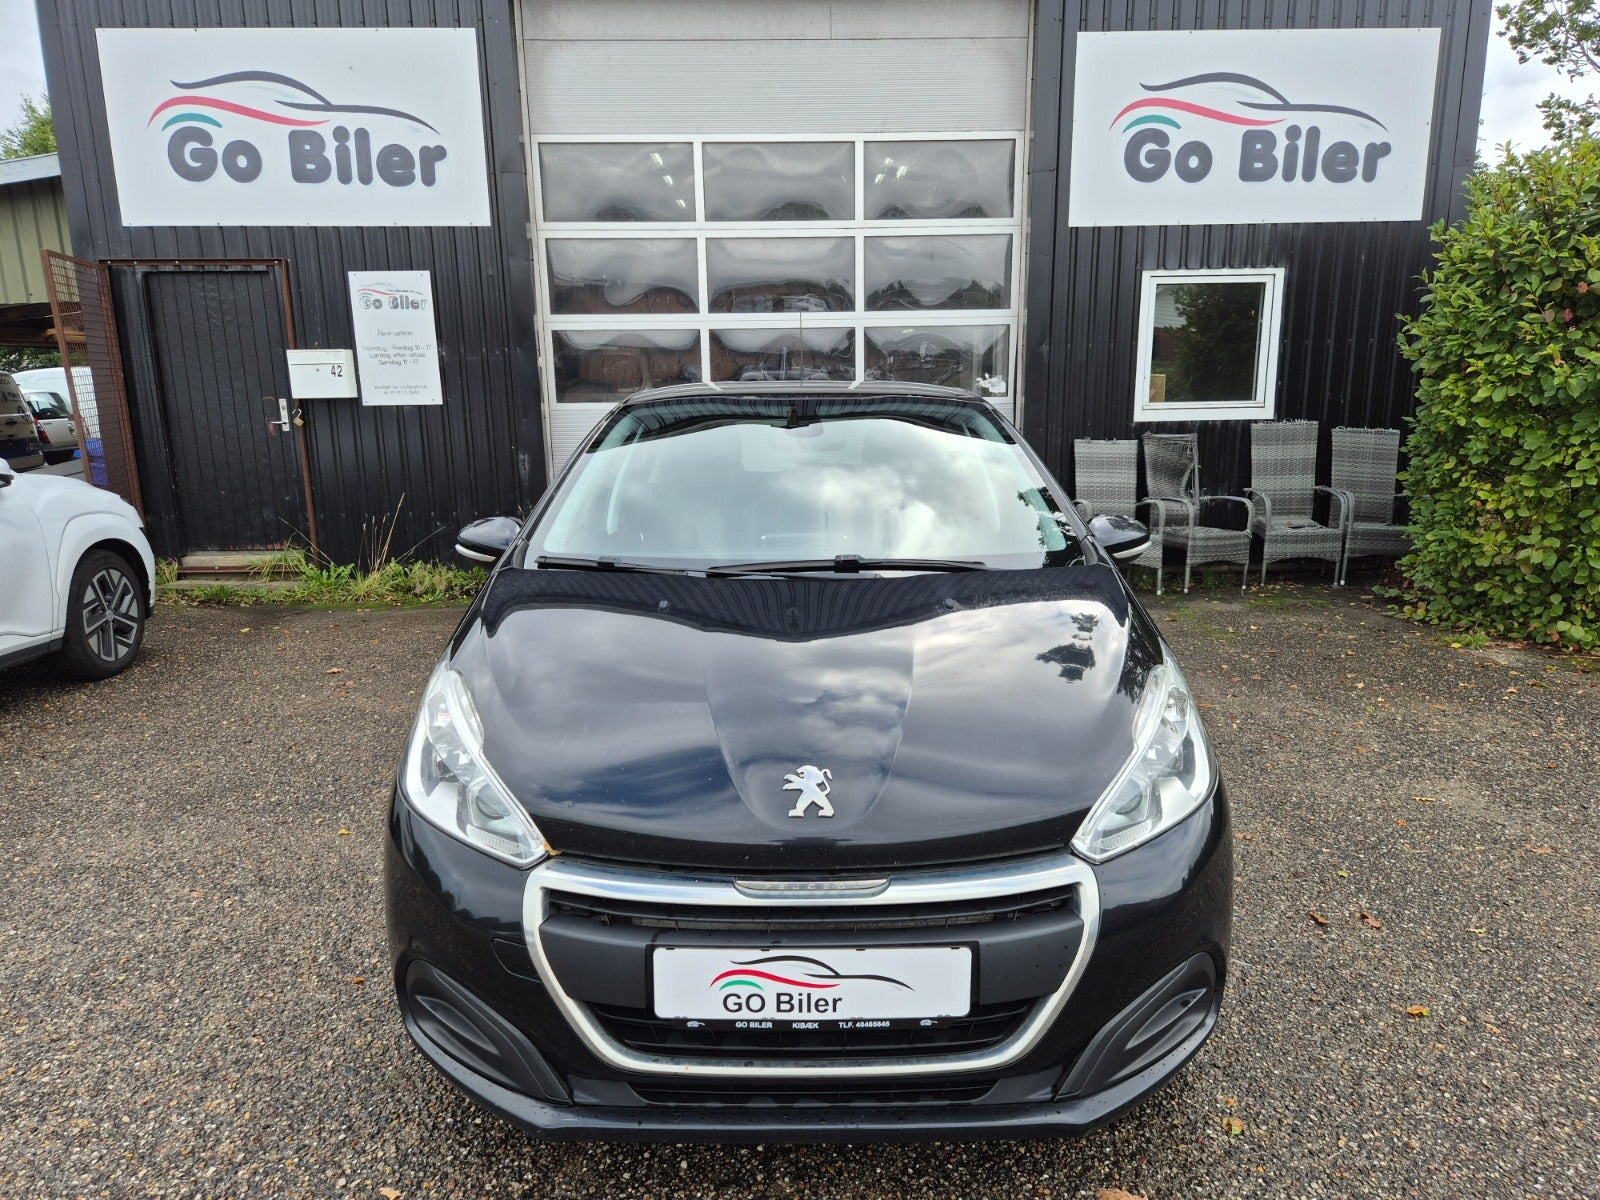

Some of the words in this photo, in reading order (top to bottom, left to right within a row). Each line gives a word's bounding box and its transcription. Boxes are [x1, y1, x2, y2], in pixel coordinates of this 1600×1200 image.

[167, 125, 262, 184] Go
[288, 125, 448, 187] Biler
[1123, 127, 1213, 183] Go
[1239, 125, 1392, 184] Biler
[359, 296, 383, 310] Go
[389, 295, 428, 310] Biler
[331, 364, 343, 378] 42
[722, 992, 766, 1013] GO
[776, 992, 843, 1013] Biler
[735, 1021, 748, 1029] GO
[749, 1021, 773, 1029] BILER
[838, 1021, 855, 1029] TLF.
